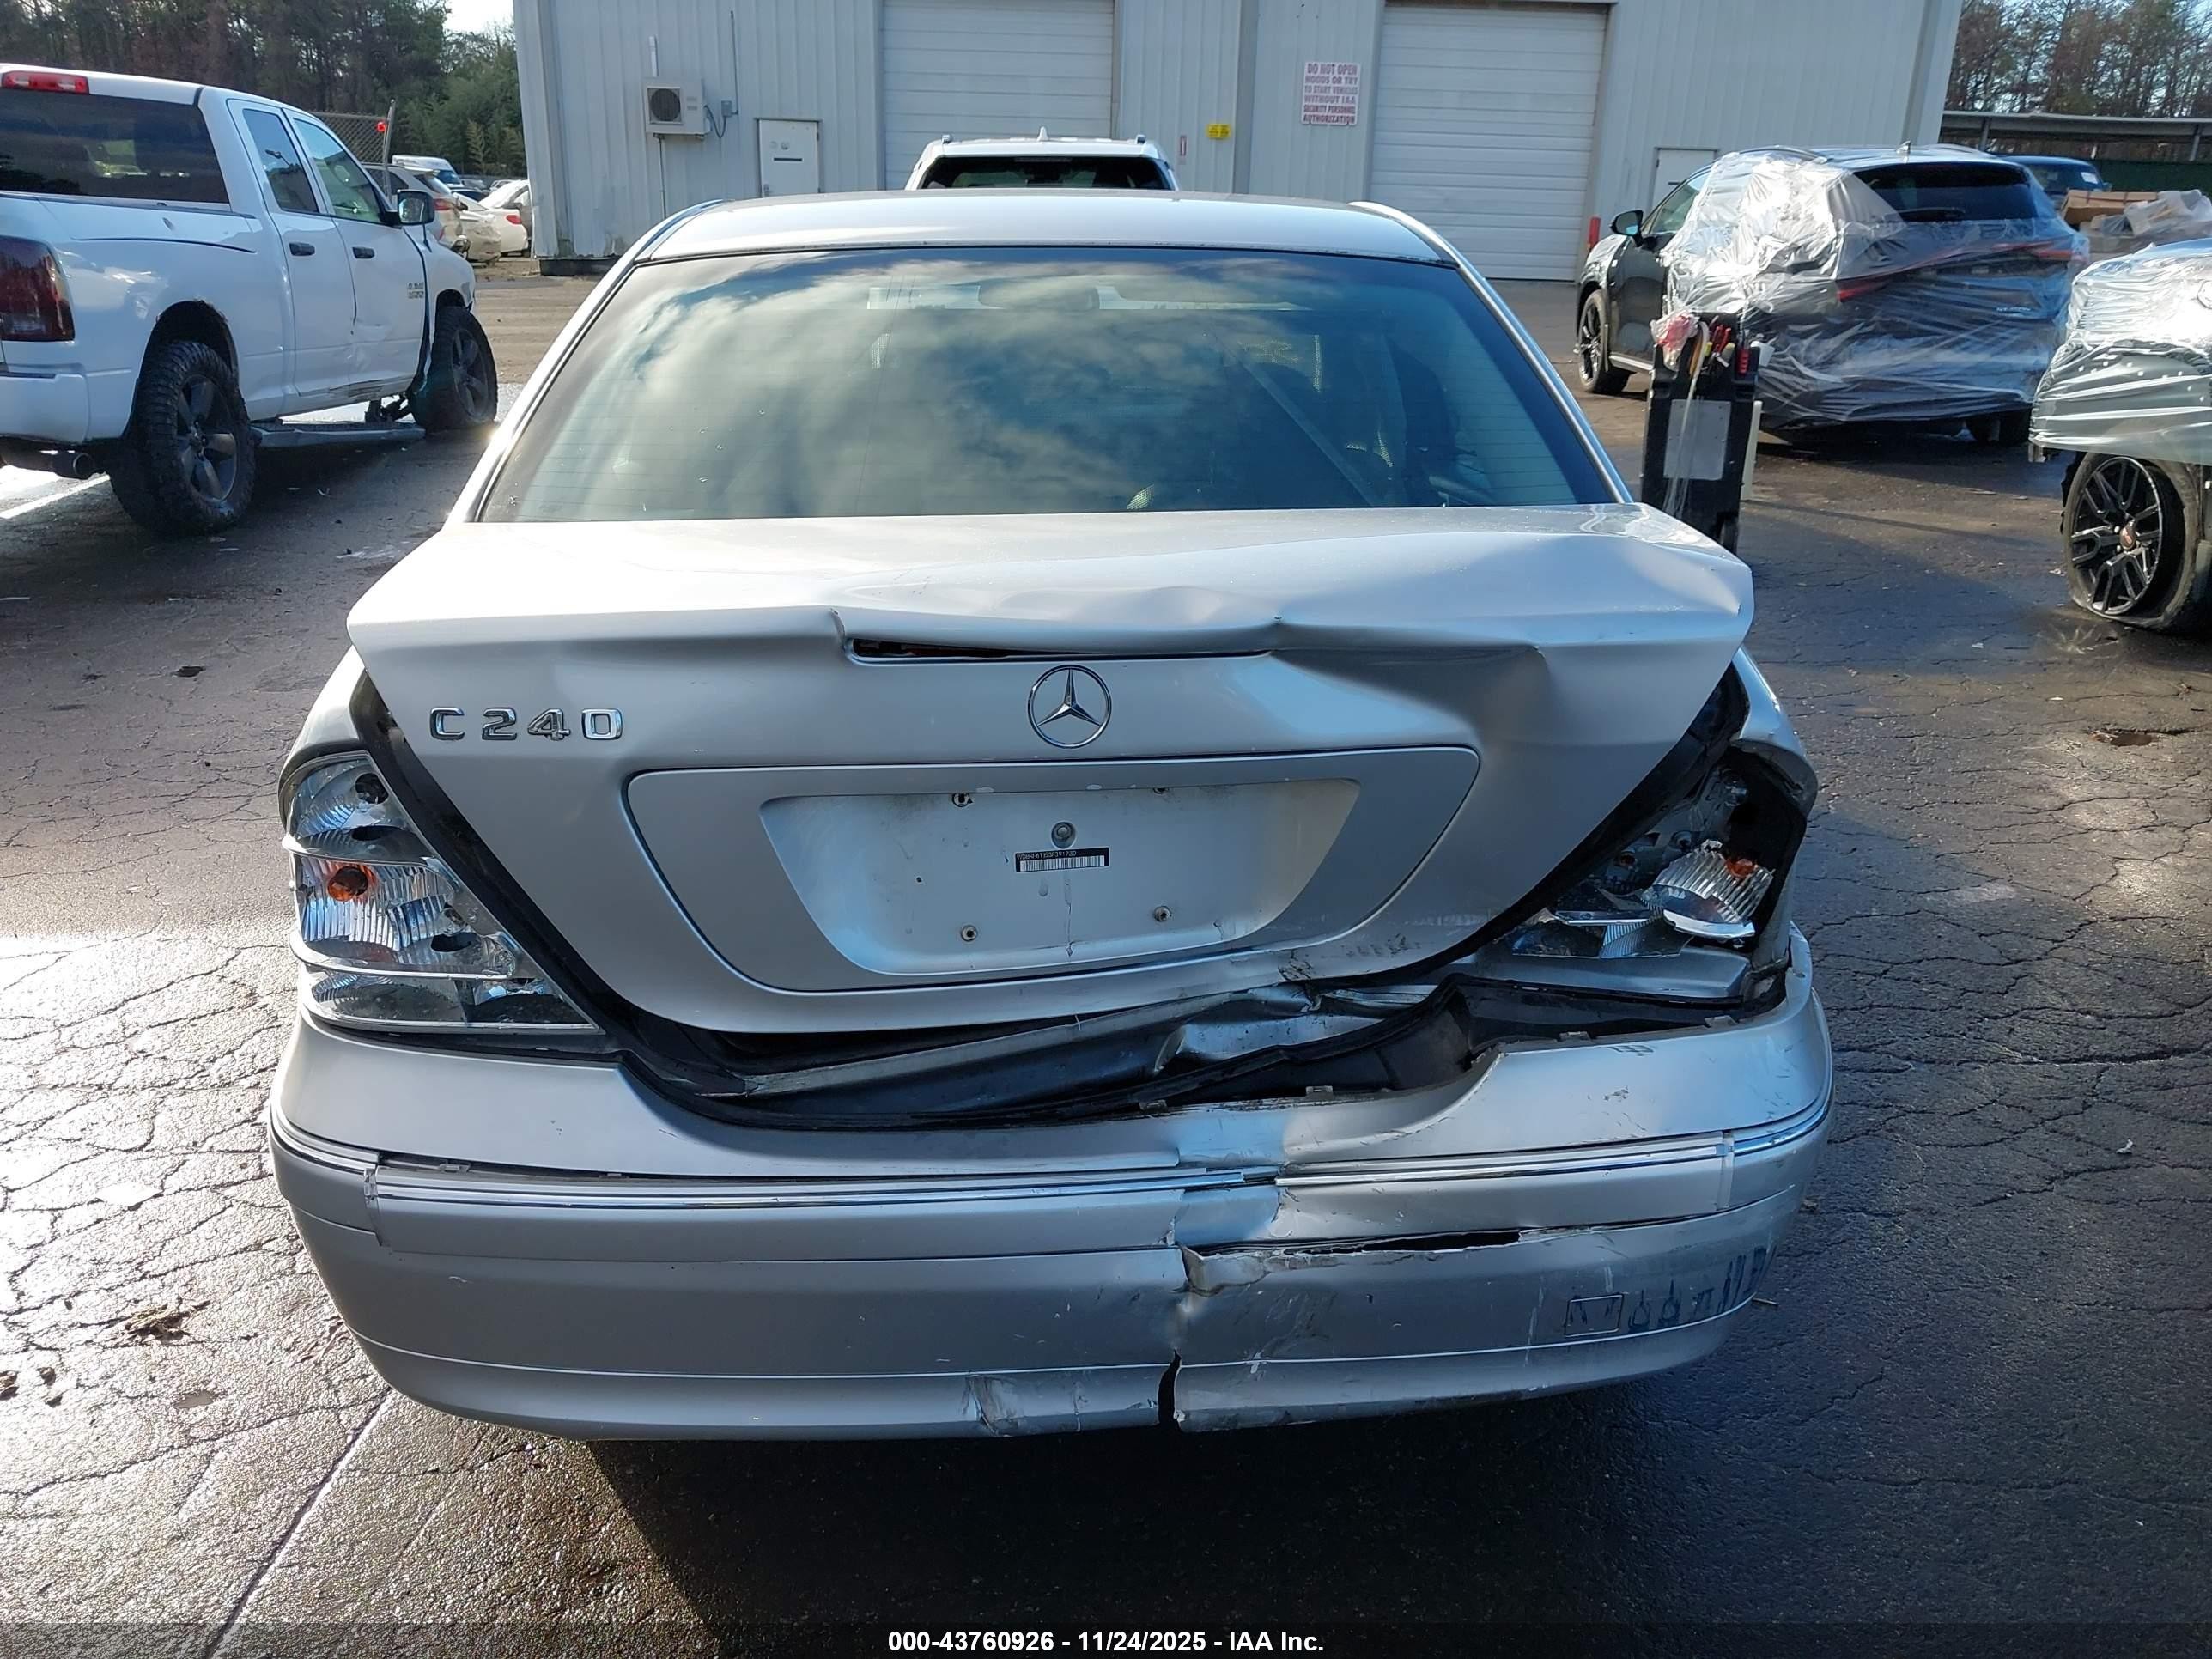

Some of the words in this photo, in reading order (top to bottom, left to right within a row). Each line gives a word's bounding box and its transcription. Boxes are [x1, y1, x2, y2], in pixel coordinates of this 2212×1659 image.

[1308, 64, 1318, 74] DO
[1320, 64, 1335, 75] NOT
[1337, 64, 1358, 76] OPEN
[1305, 76, 1330, 84] HOODS
[1313, 85, 1331, 94] START
[1333, 86, 1358, 94] VEHICLES
[1304, 95, 1340, 104] WITHOUT
[1304, 105, 1327, 113] SECURITY
[1304, 114, 1355, 124] AUTHORIZATION
[430, 707, 465, 740] C
[482, 707, 623, 741] 240
